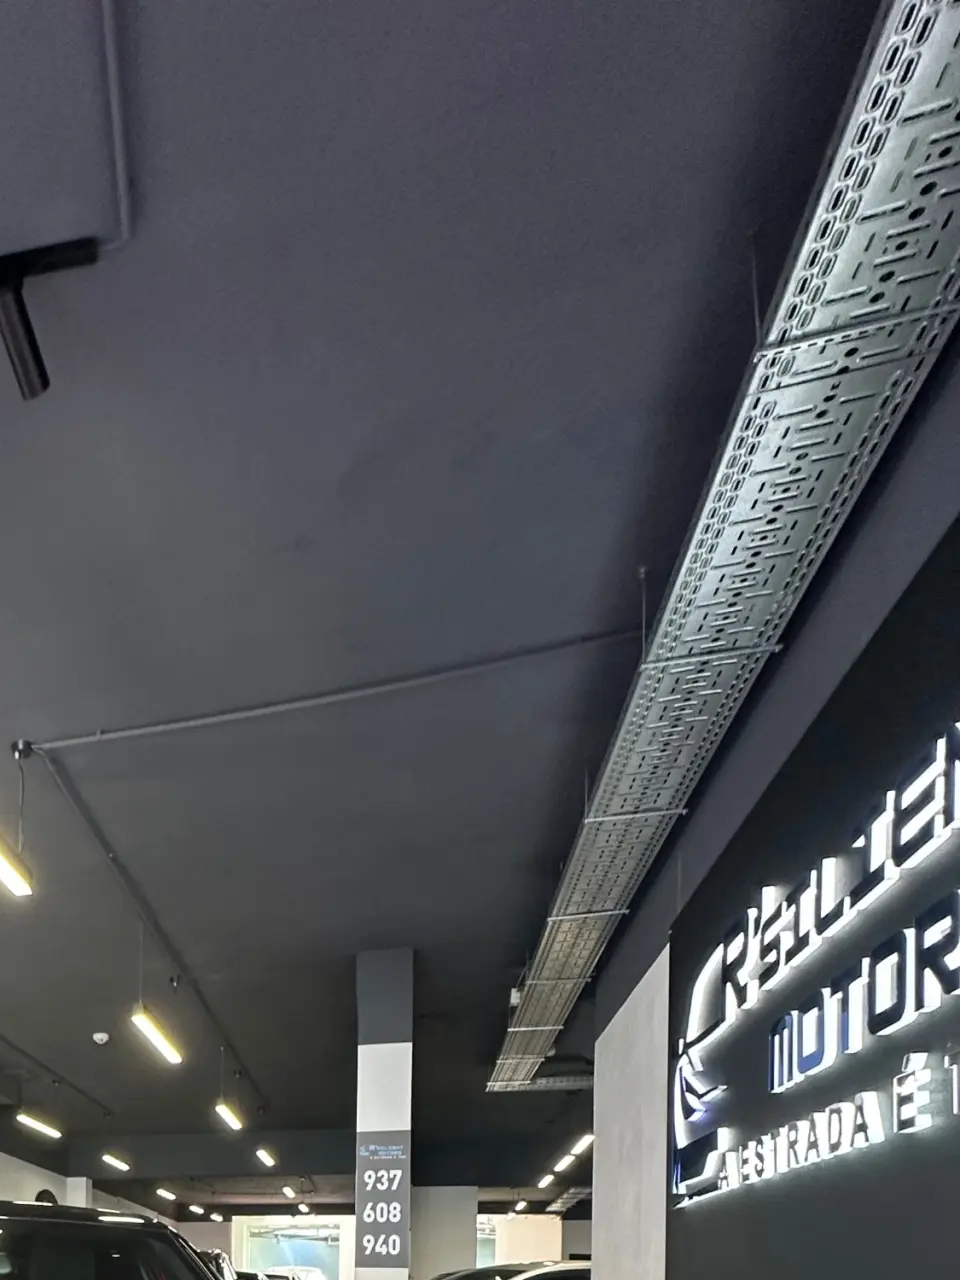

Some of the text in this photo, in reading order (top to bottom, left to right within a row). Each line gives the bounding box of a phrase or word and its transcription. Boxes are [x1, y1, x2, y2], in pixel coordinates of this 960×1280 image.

[363, 1169, 403, 1191] 937
[362, 1202, 402, 1223] 608
[362, 1234, 401, 1256] 940
